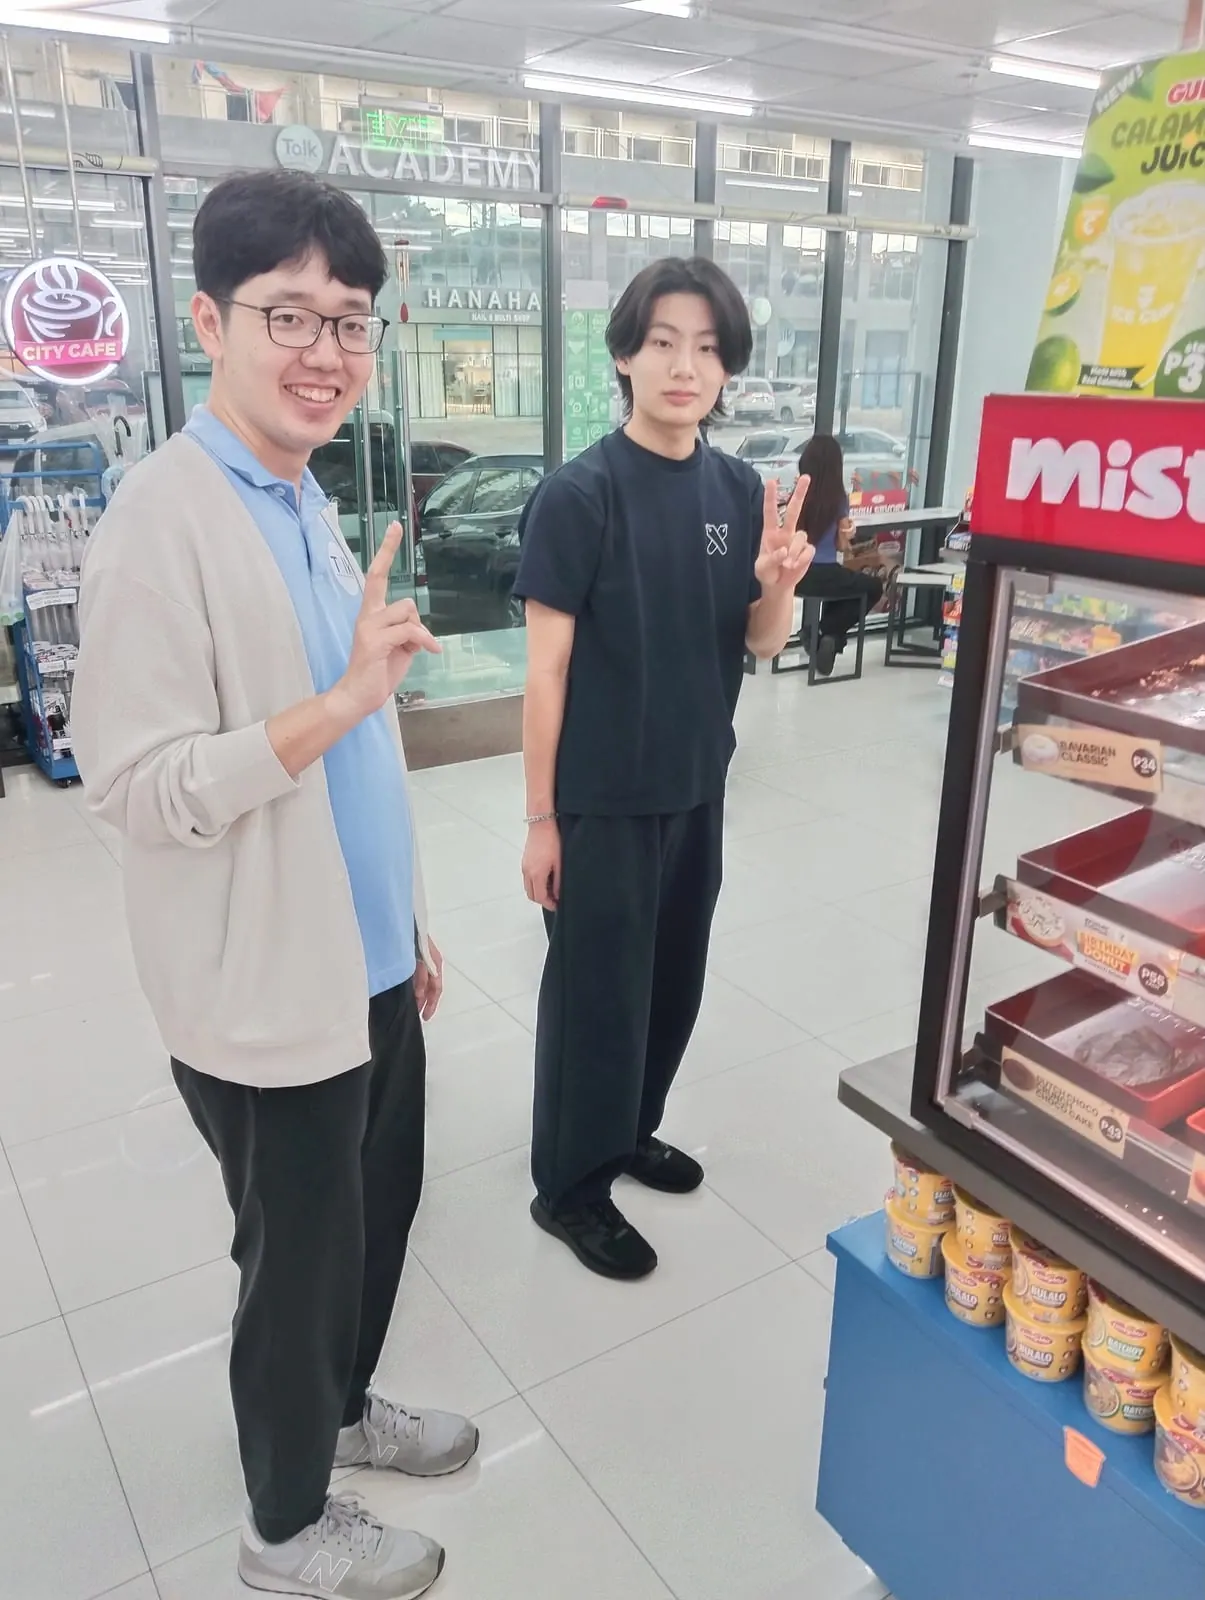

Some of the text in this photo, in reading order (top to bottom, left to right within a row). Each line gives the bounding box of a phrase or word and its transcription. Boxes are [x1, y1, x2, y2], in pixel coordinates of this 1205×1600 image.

[282, 139, 318, 158] Talk
[327, 134, 540, 192] ACADEMY
[427, 287, 568, 311] HANAHA
[22, 342, 117, 361] CITY CAFE
[1060, 740, 1116, 757] BAVARIAN
[1061, 752, 1109, 767] CLASSIC
[1080, 931, 1135, 960] BIRTHDAY
[1083, 944, 1126, 972] DONUT
[1031, 1285, 1066, 1302] BULALO
[1018, 1343, 1053, 1361] BULALO
